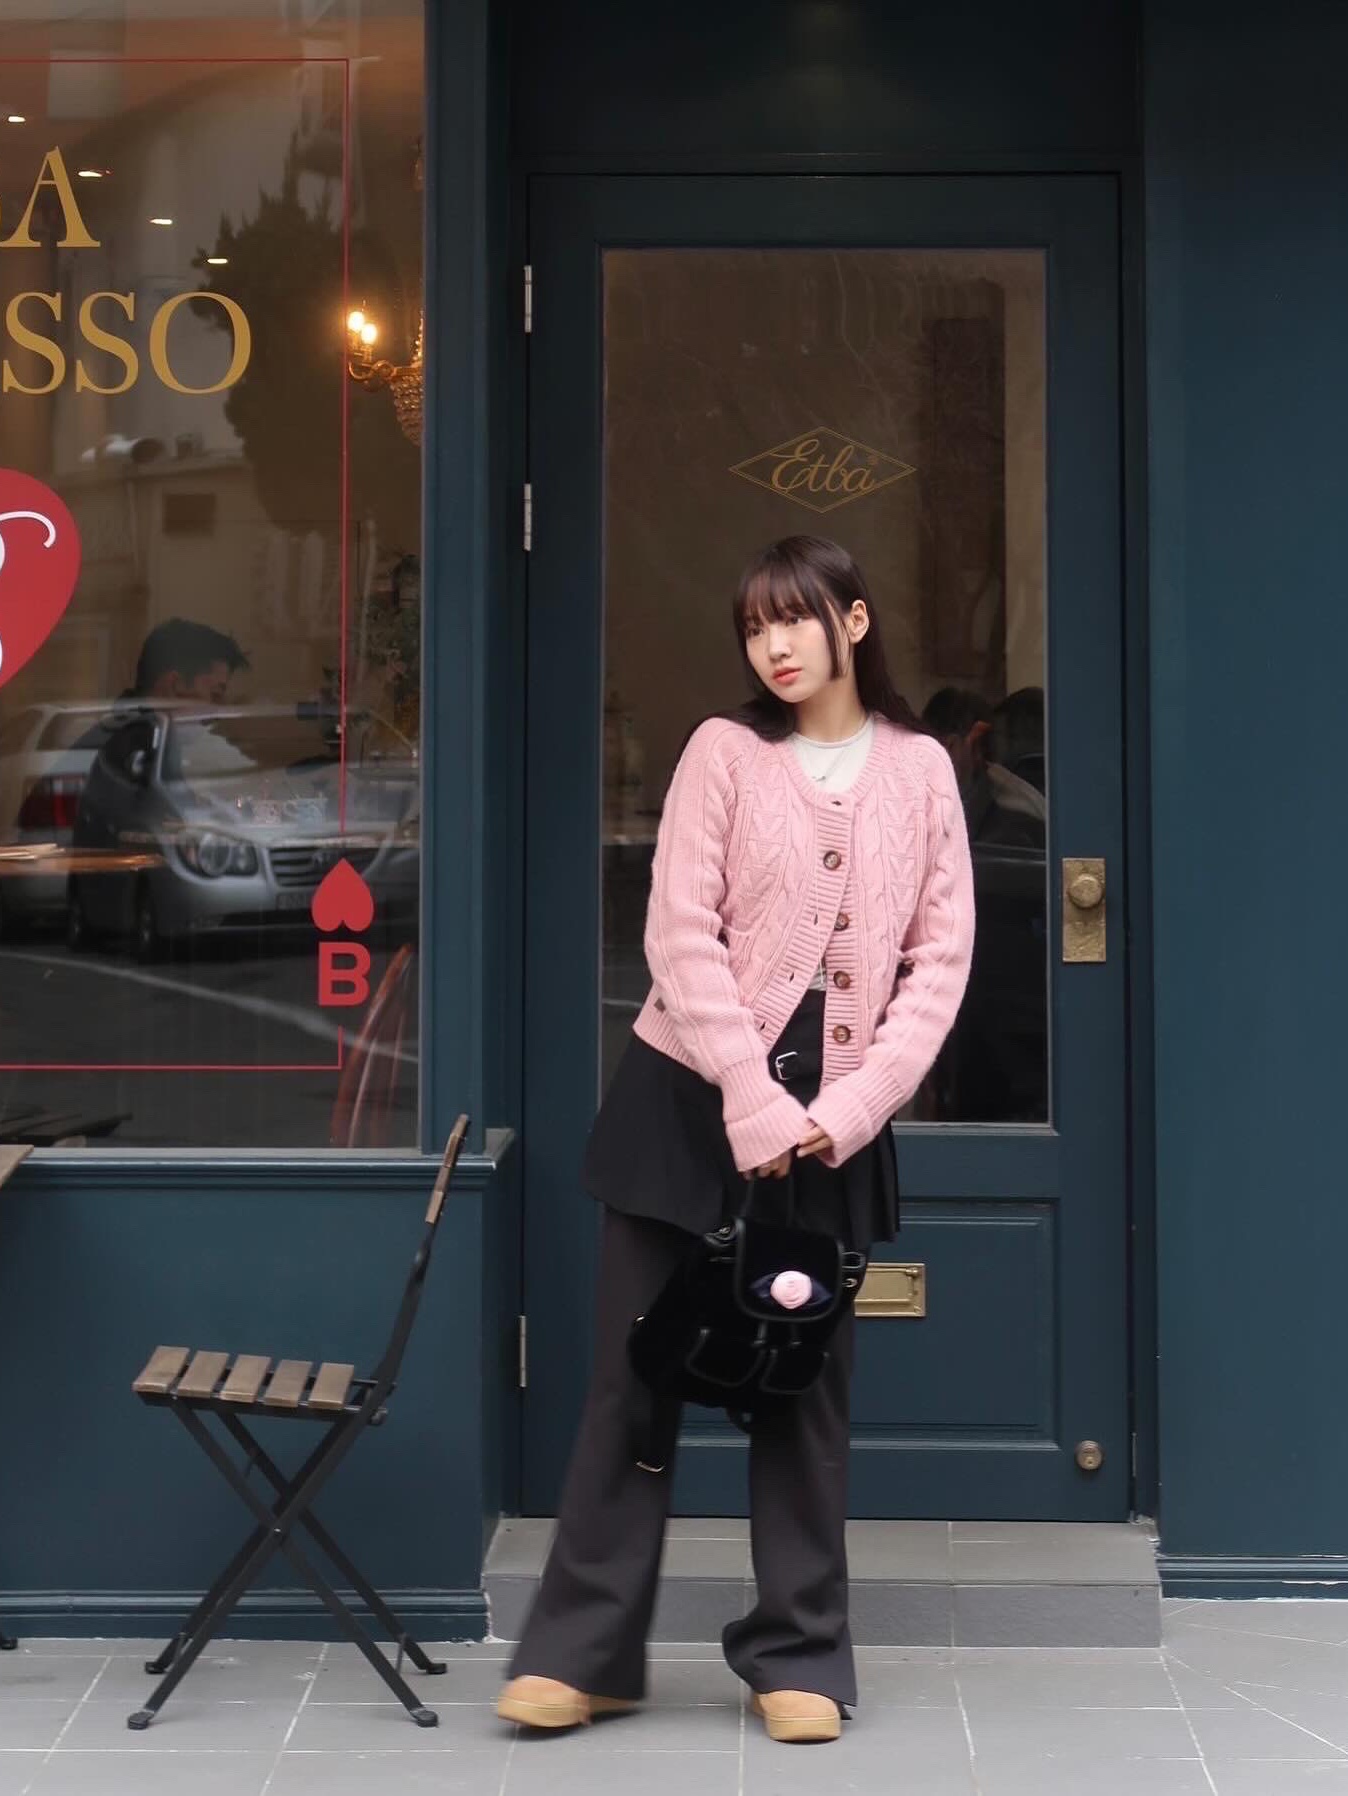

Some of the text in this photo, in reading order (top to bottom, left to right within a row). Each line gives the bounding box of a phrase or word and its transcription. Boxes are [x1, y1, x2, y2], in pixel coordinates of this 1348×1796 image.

[2, 291, 251, 394] SSO
[771, 438, 876, 493] Etba
[318, 942, 371, 1006] B
